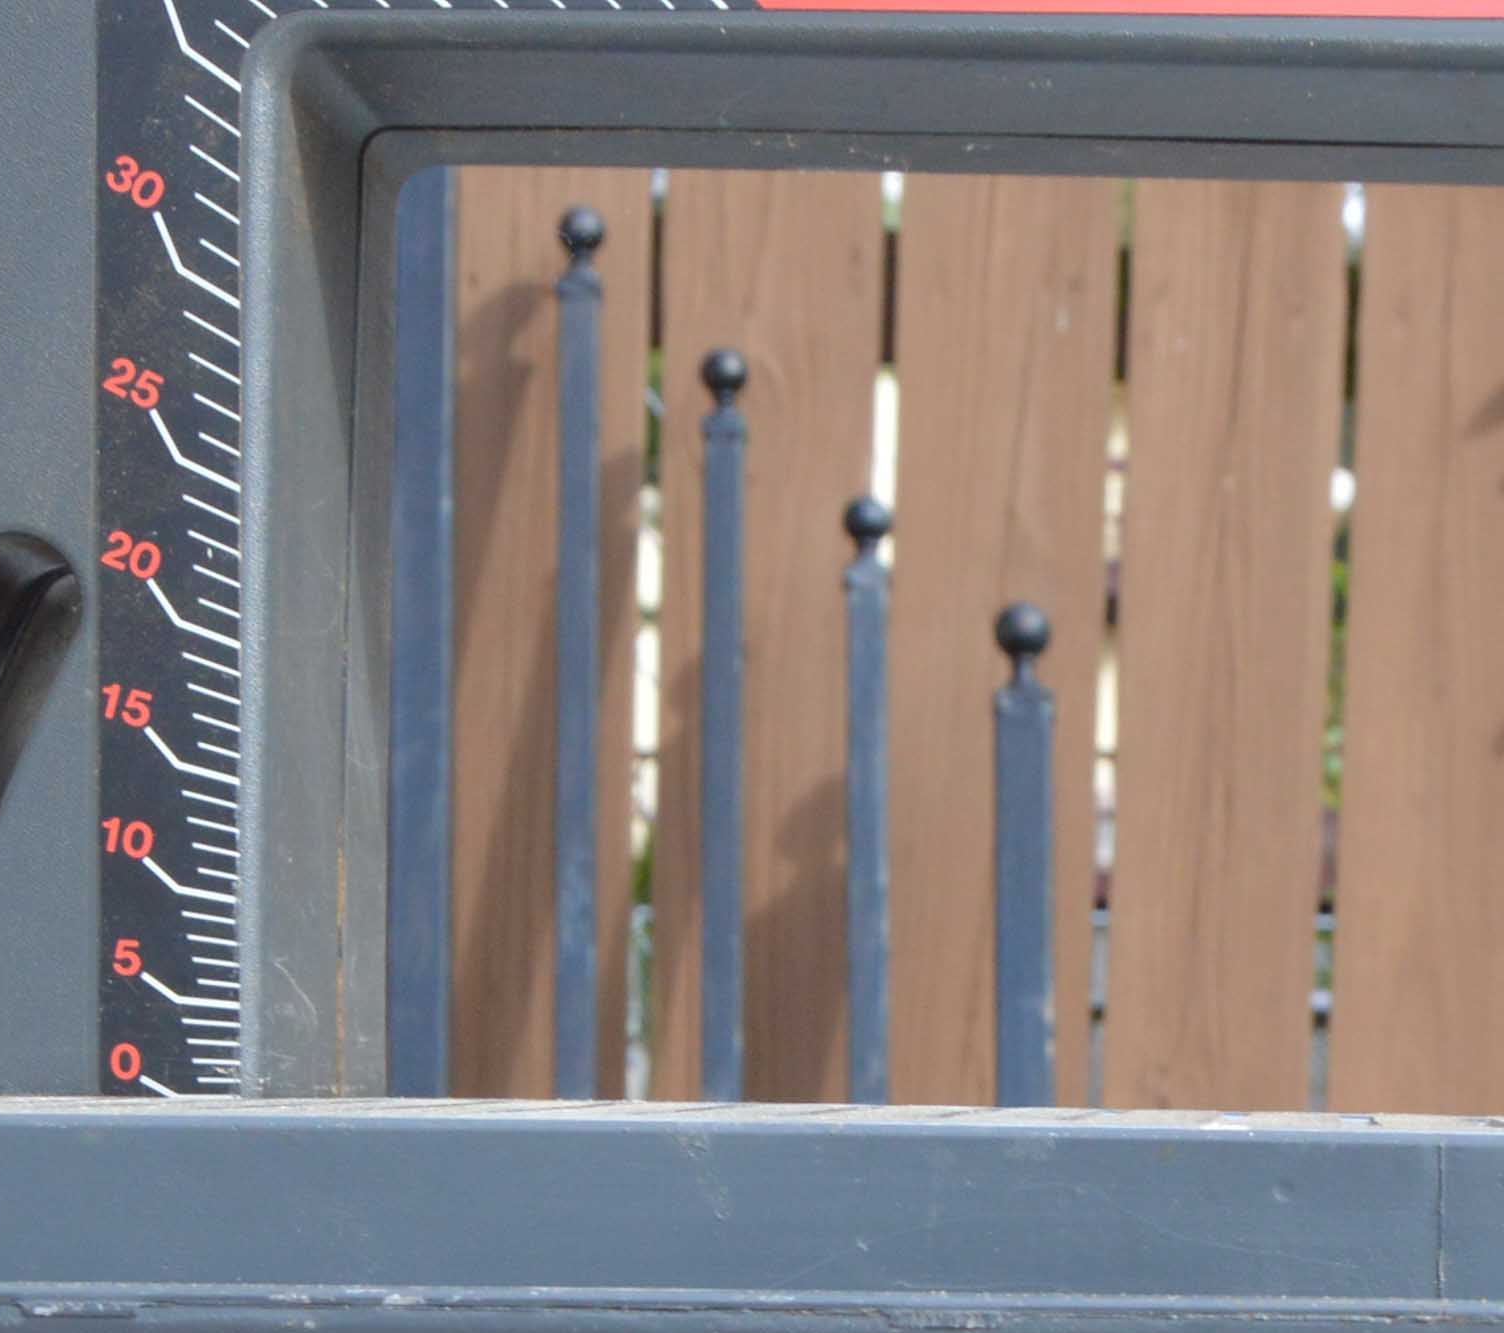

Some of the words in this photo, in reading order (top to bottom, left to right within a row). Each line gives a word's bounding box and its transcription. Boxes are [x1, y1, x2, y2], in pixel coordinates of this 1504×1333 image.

[105, 154, 166, 210] 30
[102, 356, 165, 410] 25
[100, 529, 163, 580] 20
[101, 683, 154, 728] 15
[101, 816, 155, 860] 10
[112, 938, 144, 978] 5
[110, 1042, 142, 1081] 0
